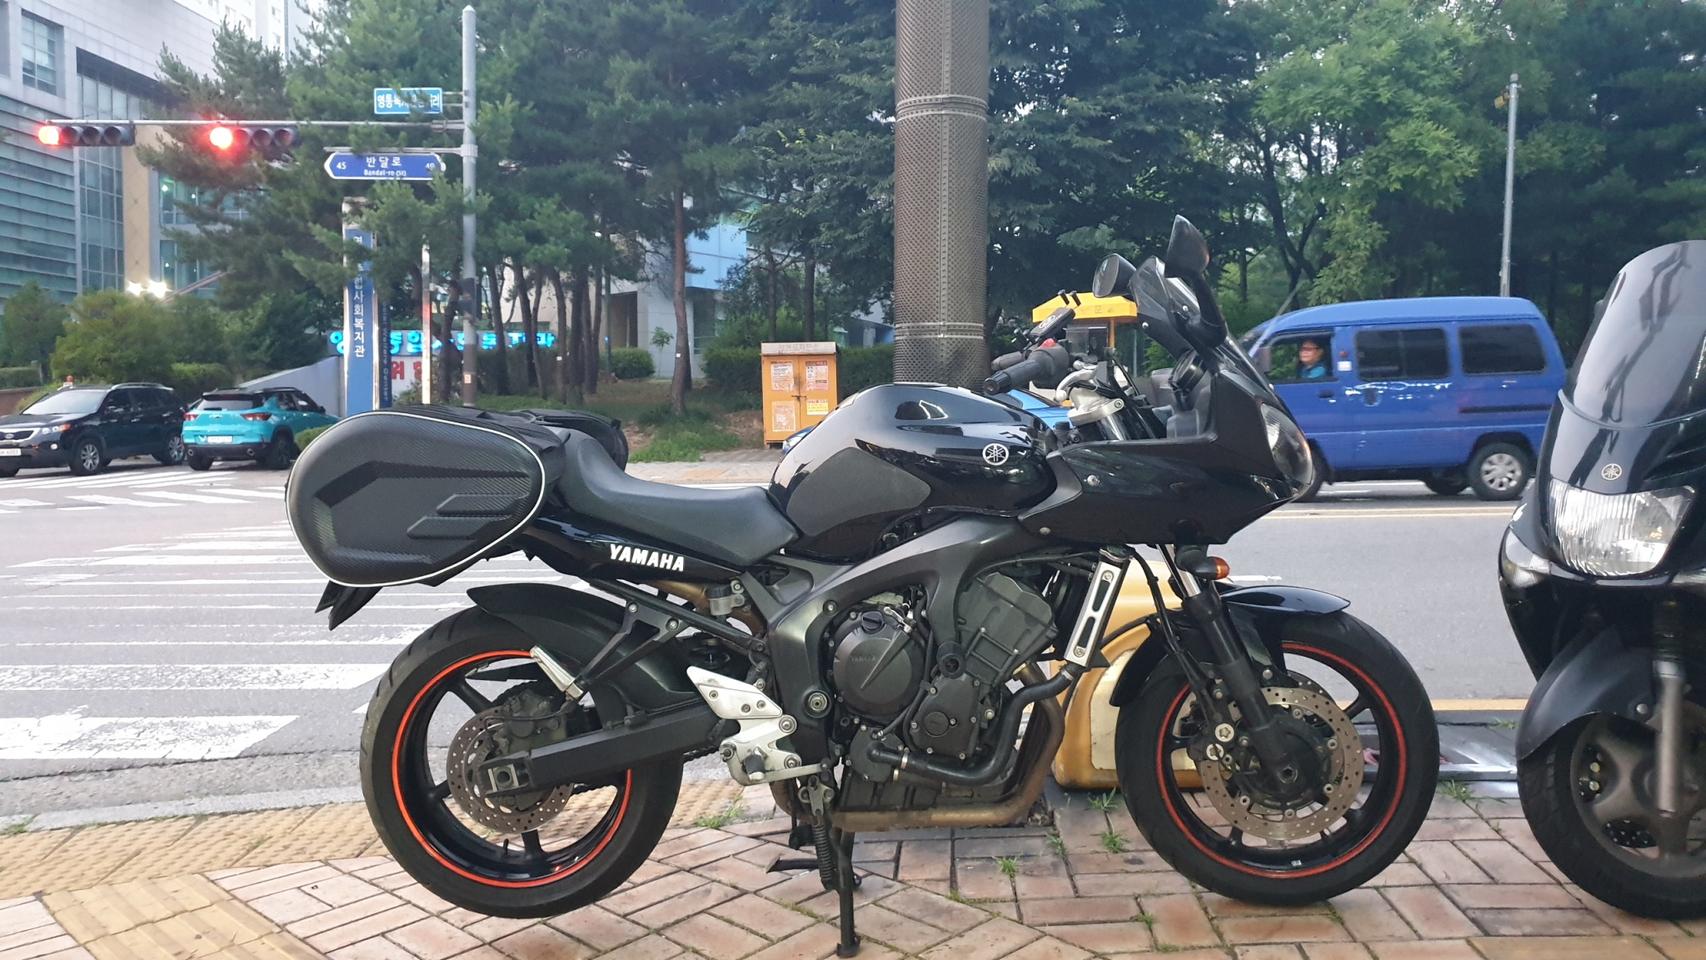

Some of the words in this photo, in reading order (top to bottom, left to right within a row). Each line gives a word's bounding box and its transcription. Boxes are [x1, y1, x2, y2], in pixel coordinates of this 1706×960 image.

[336, 161, 348, 170] 45
[366, 156, 402, 169] 반달로
[610, 543, 685, 572] YAMAHA
